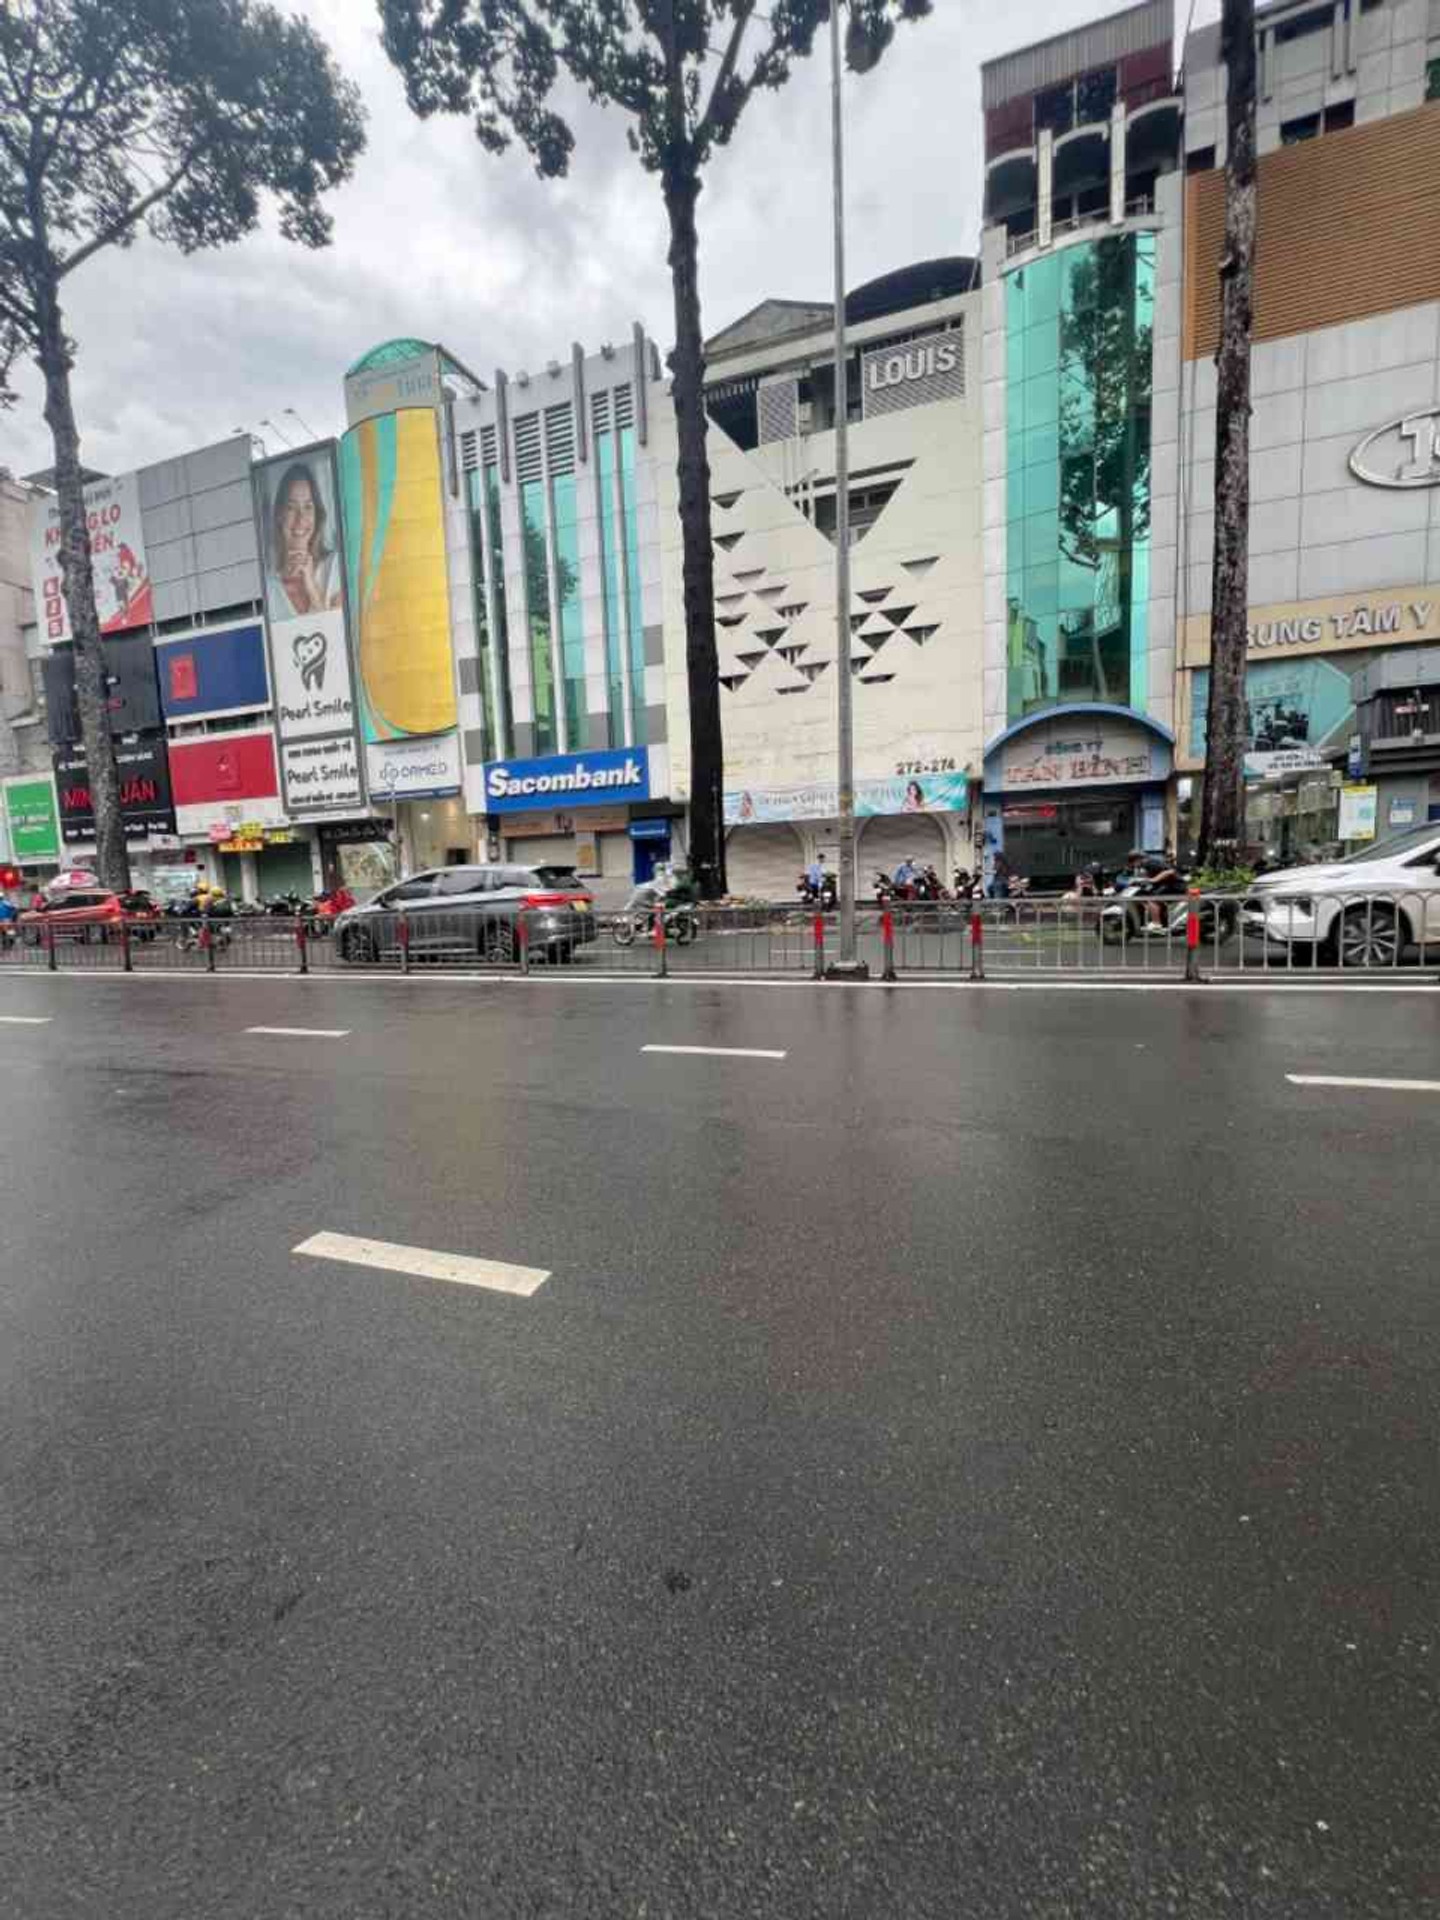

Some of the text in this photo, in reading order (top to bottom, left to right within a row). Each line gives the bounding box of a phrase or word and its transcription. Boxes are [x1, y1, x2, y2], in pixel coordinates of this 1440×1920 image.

[870, 344, 956, 390] LOUIS
[1329, 606, 1401, 636] TÂM
[1410, 602, 1431, 629] Y
[281, 698, 352, 721] Pearl Smile
[288, 762, 359, 784] Pearl Smile
[488, 758, 642, 797] Sacombank
